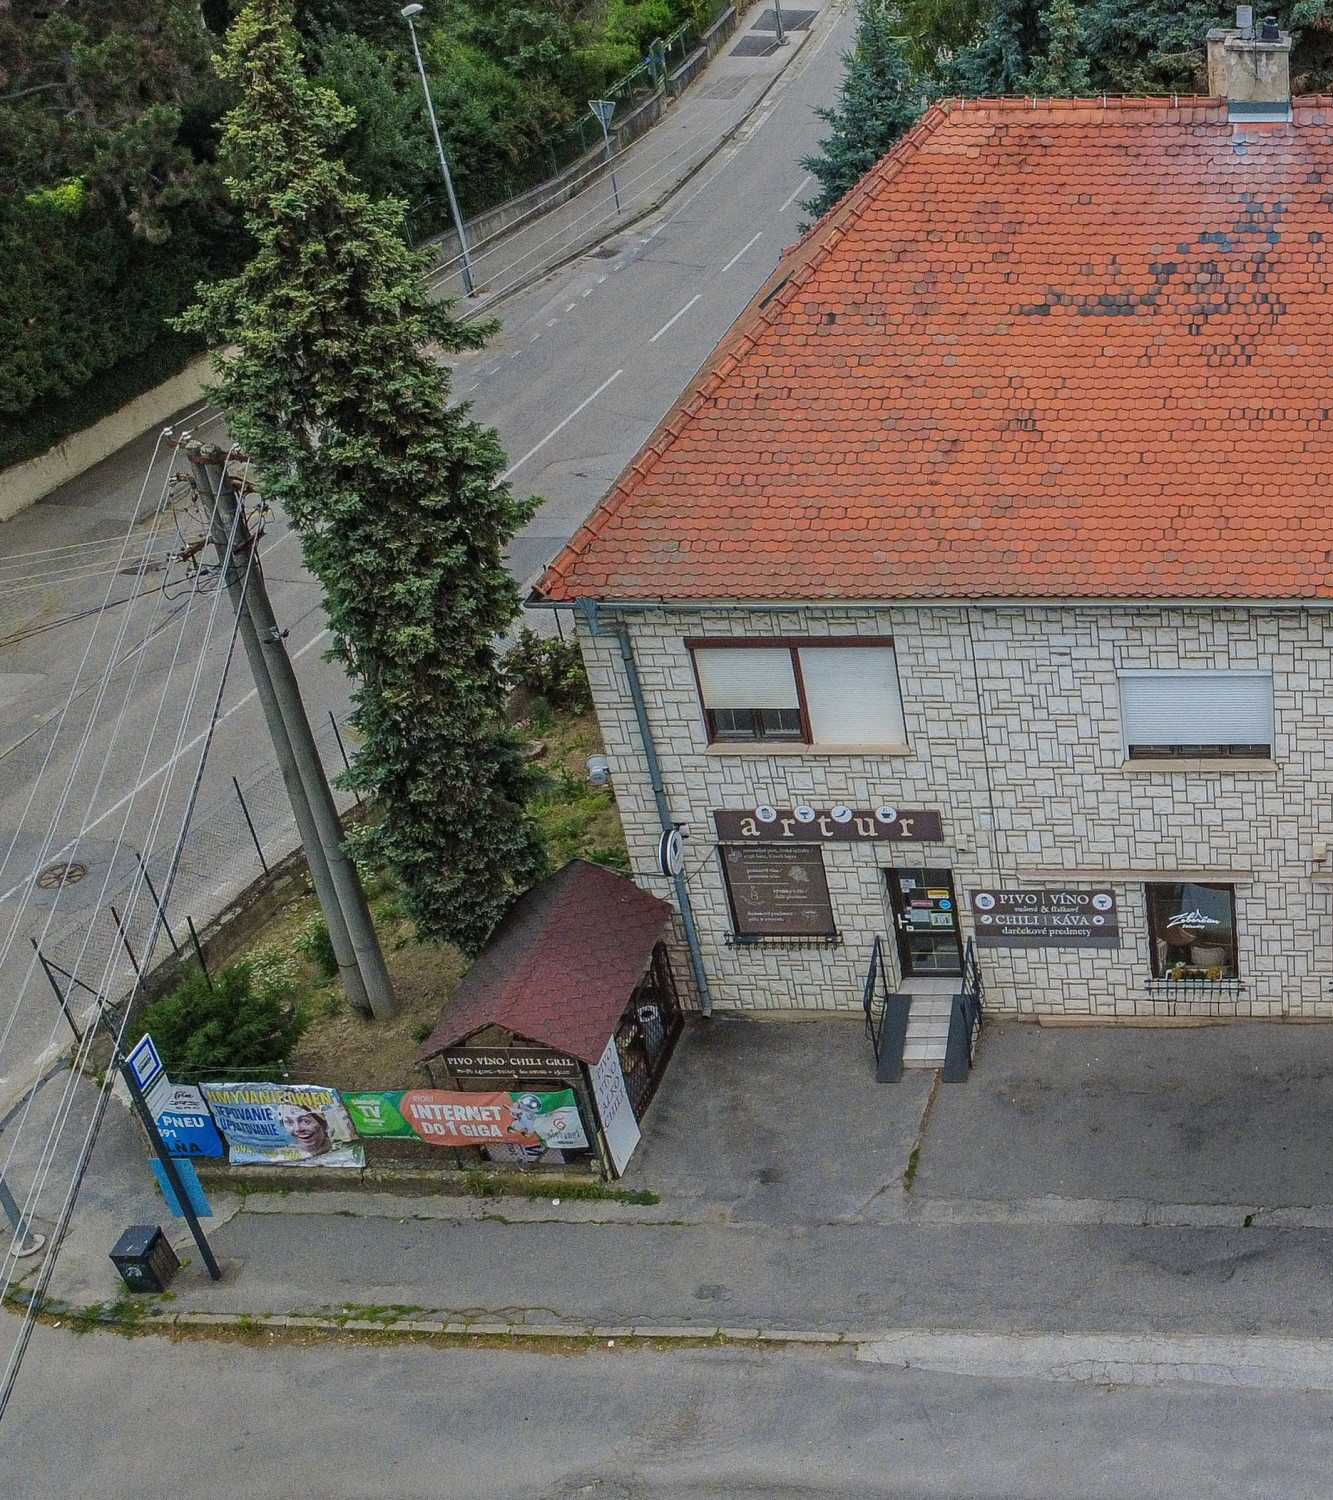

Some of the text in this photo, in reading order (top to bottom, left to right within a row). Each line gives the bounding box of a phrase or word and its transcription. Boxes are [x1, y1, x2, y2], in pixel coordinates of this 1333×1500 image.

[740, 816, 915, 837] artur
[999, 892, 1089, 905] PIVO VÍNO
[995, 913, 1090, 926] CHILI KÁVA
[1002, 926, 1092, 937] darčekové predmety
[447, 1056, 575, 1066] PIVO VÍNO CHILI GRIL
[357, 1105, 381, 1119] TV
[410, 1104, 503, 1122] INTERNET
[162, 1115, 205, 1128] PNEU
[421, 1120, 504, 1138] DO 1 GIGA
